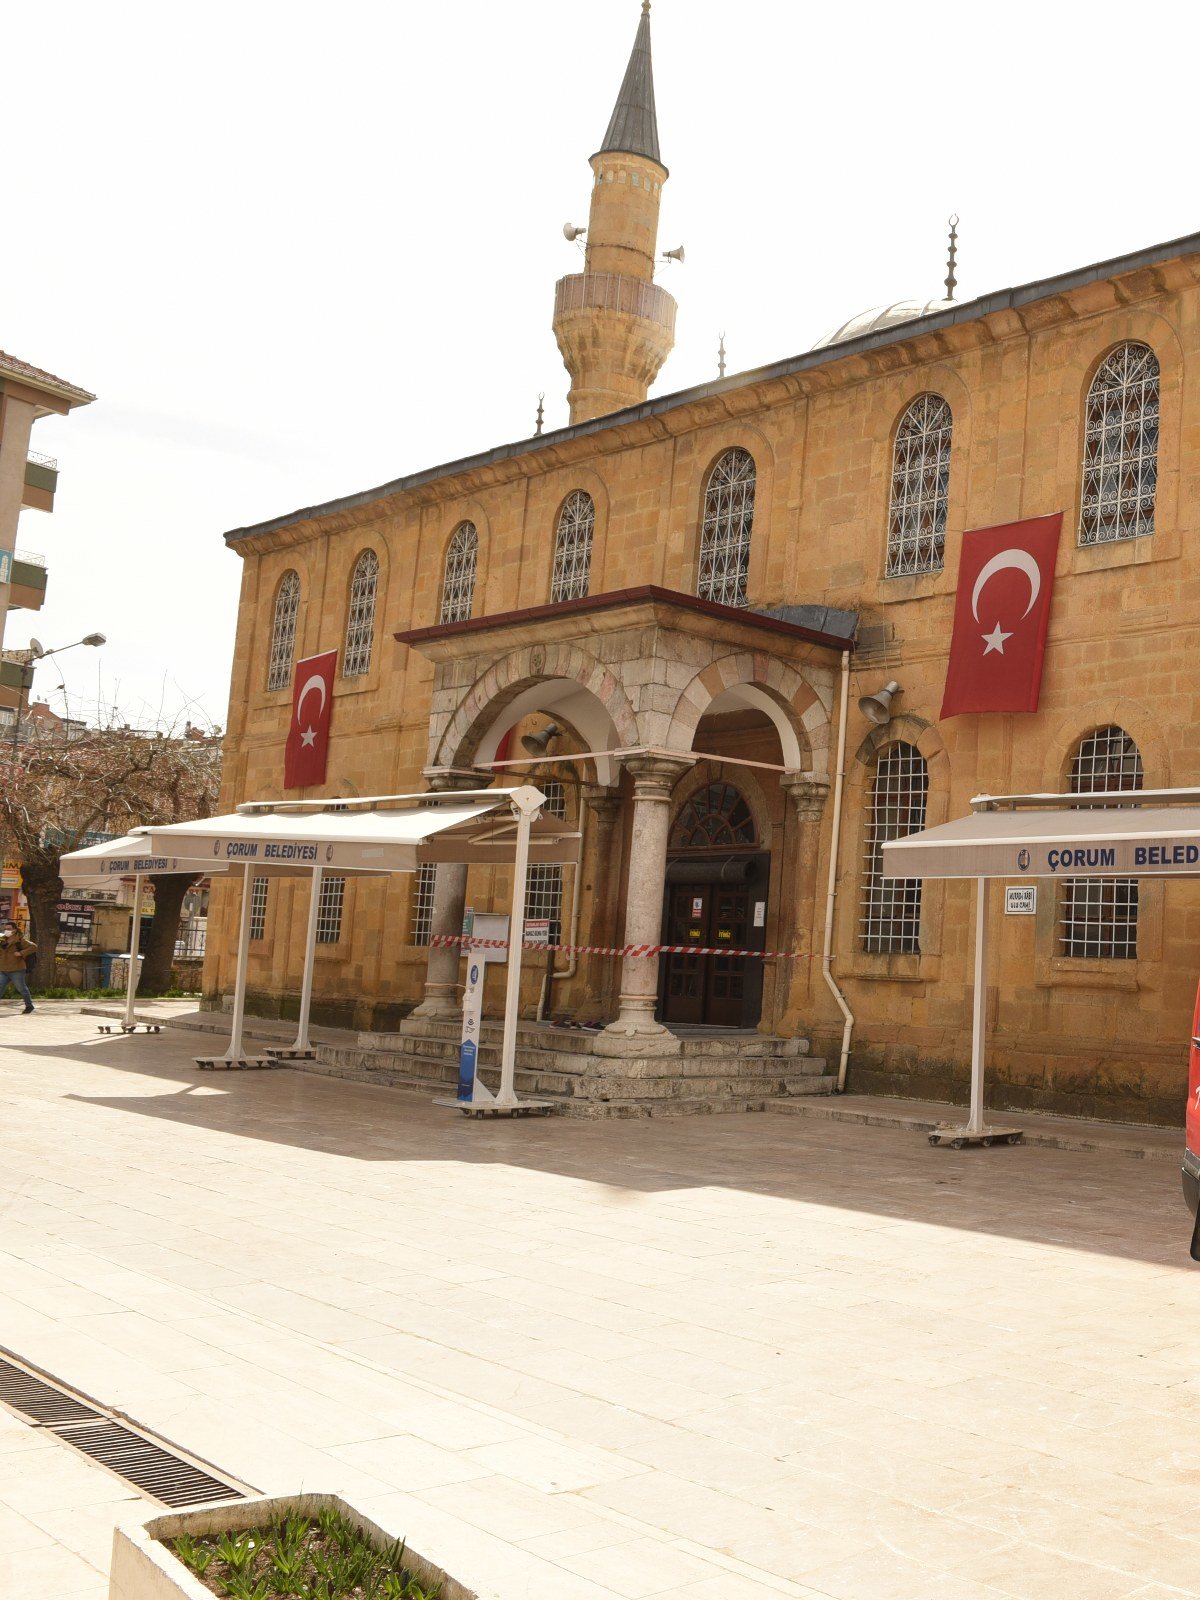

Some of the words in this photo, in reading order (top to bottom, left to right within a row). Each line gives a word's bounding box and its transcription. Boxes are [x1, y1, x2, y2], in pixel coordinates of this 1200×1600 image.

[226, 842, 258, 859] ÇORUM
[264, 841, 318, 860] BELEDİYESİ
[109, 860, 129, 873] ÇORUM
[1047, 849, 1115, 872] ÇORUM
